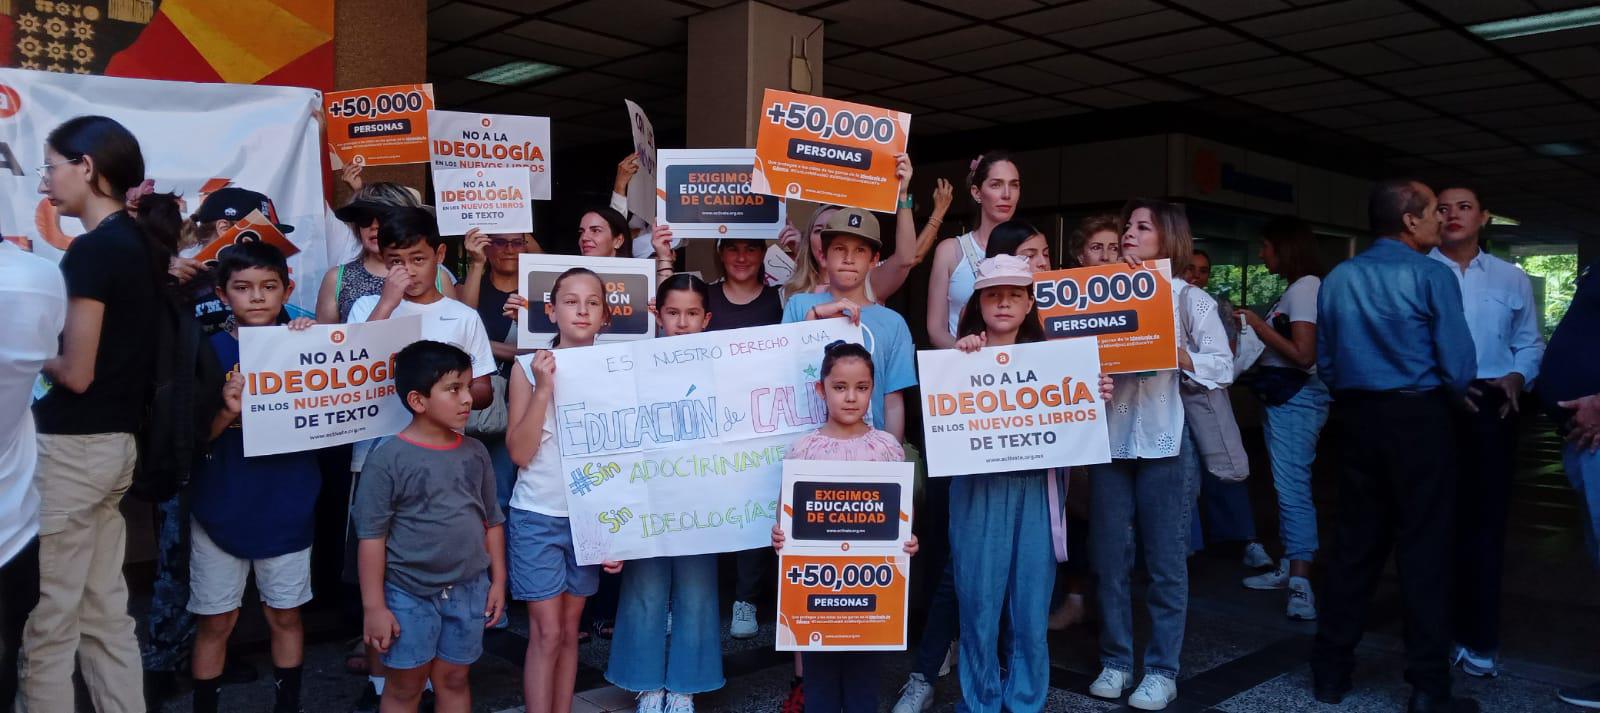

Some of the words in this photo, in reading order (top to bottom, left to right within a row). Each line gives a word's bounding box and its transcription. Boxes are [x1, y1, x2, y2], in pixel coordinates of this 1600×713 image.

[329, 92, 424, 119] +50,000
[354, 121, 404, 134] PERSONAS
[766, 101, 895, 144] +50,000
[462, 130, 479, 141] NO
[483, 131, 492, 141] A
[494, 132, 508, 142] LA
[433, 140, 545, 162] IDEOLOGÍA
[796, 143, 862, 163] PERSONAS
[486, 180, 496, 188] LA
[679, 181, 750, 195] EDUCACIÓ
[441, 186, 523, 202] IDEOLOGÍA
[681, 195, 700, 206] DE
[704, 195, 764, 206] CALIDAD
[461, 202, 494, 210] NUEVOS
[461, 212, 473, 220] DE
[475, 211, 505, 219] TEXTO
[1053, 315, 1127, 331] PERSONAS
[299, 352, 327, 365] NO
[332, 350, 345, 363] A
[349, 348, 369, 361] LA
[606, 355, 635, 373] ES
[653, 346, 723, 367] NUESTRO
[730, 336, 789, 357] DERECHO
[801, 330, 831, 346] UNA
[248, 352, 398, 396] IDEOLOGÍ
[970, 374, 995, 387] NO
[1000, 372, 1012, 384] A
[1016, 369, 1038, 383] LA
[251, 404, 265, 413] EN
[268, 402, 289, 412] LOS
[294, 391, 361, 410] NUEVOS
[365, 384, 396, 400] LIBR
[927, 376, 1095, 417] IDEOLOGÍA
[294, 414, 319, 429] DE
[324, 404, 378, 425] TEXTO
[723, 405, 746, 433] de
[932, 425, 944, 433] EN
[946, 423, 965, 432] LOS
[968, 415, 1034, 431] NUEVOS
[1038, 408, 1097, 426] LIBROS
[970, 437, 993, 451] DE
[997, 431, 1057, 449] TEXTO
[568, 459, 622, 497] #Sin
[815, 490, 881, 501] EXIGIMOS
[806, 500, 884, 512] EDUCACIÓN
[597, 505, 634, 534] Sin
[807, 512, 825, 523] DE
[828, 512, 886, 523] CALIDAD
[786, 563, 893, 592] +50,000
[814, 598, 869, 607] PERSONAS
